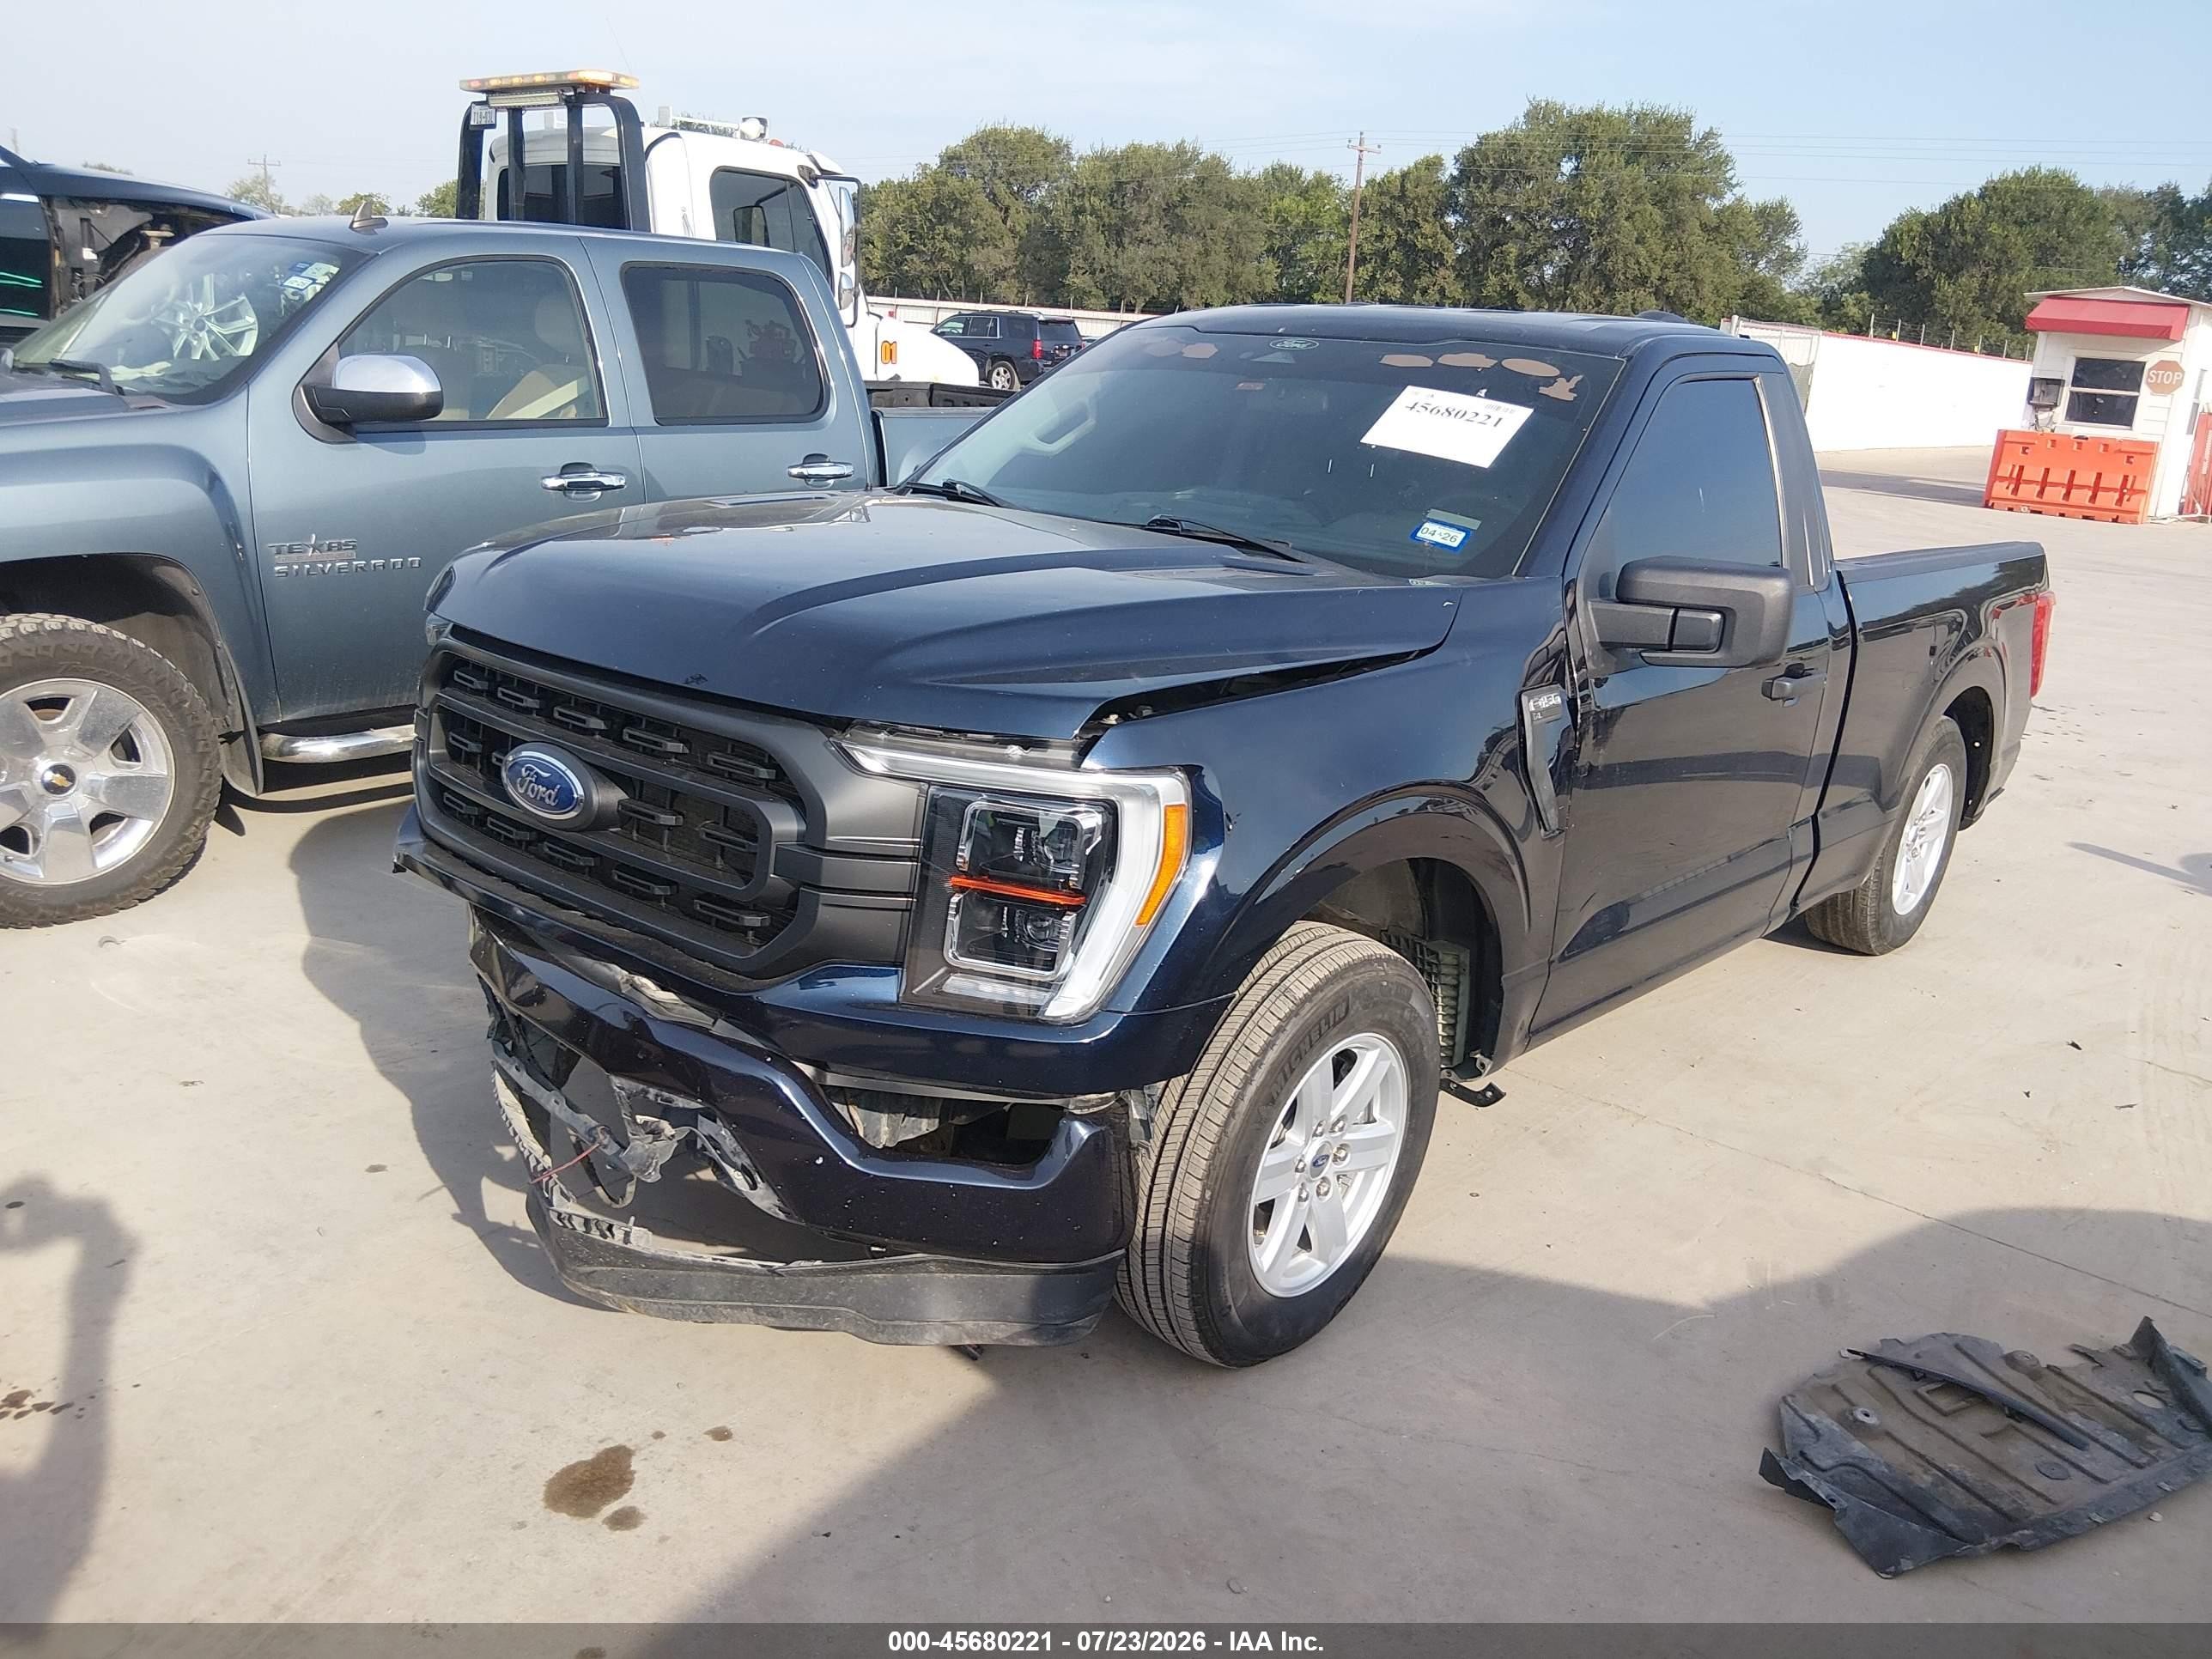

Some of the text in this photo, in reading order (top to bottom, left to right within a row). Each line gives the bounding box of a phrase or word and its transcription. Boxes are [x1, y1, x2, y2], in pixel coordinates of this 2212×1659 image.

[880, 340, 897, 364] 01
[2148, 369, 2183, 385] STOP
[1406, 401, 1504, 428] 45680221
[268, 533, 358, 556] TEXAS
[274, 557, 422, 578] SILVERADO
[1271, 994, 1352, 1105] MICHELIN
